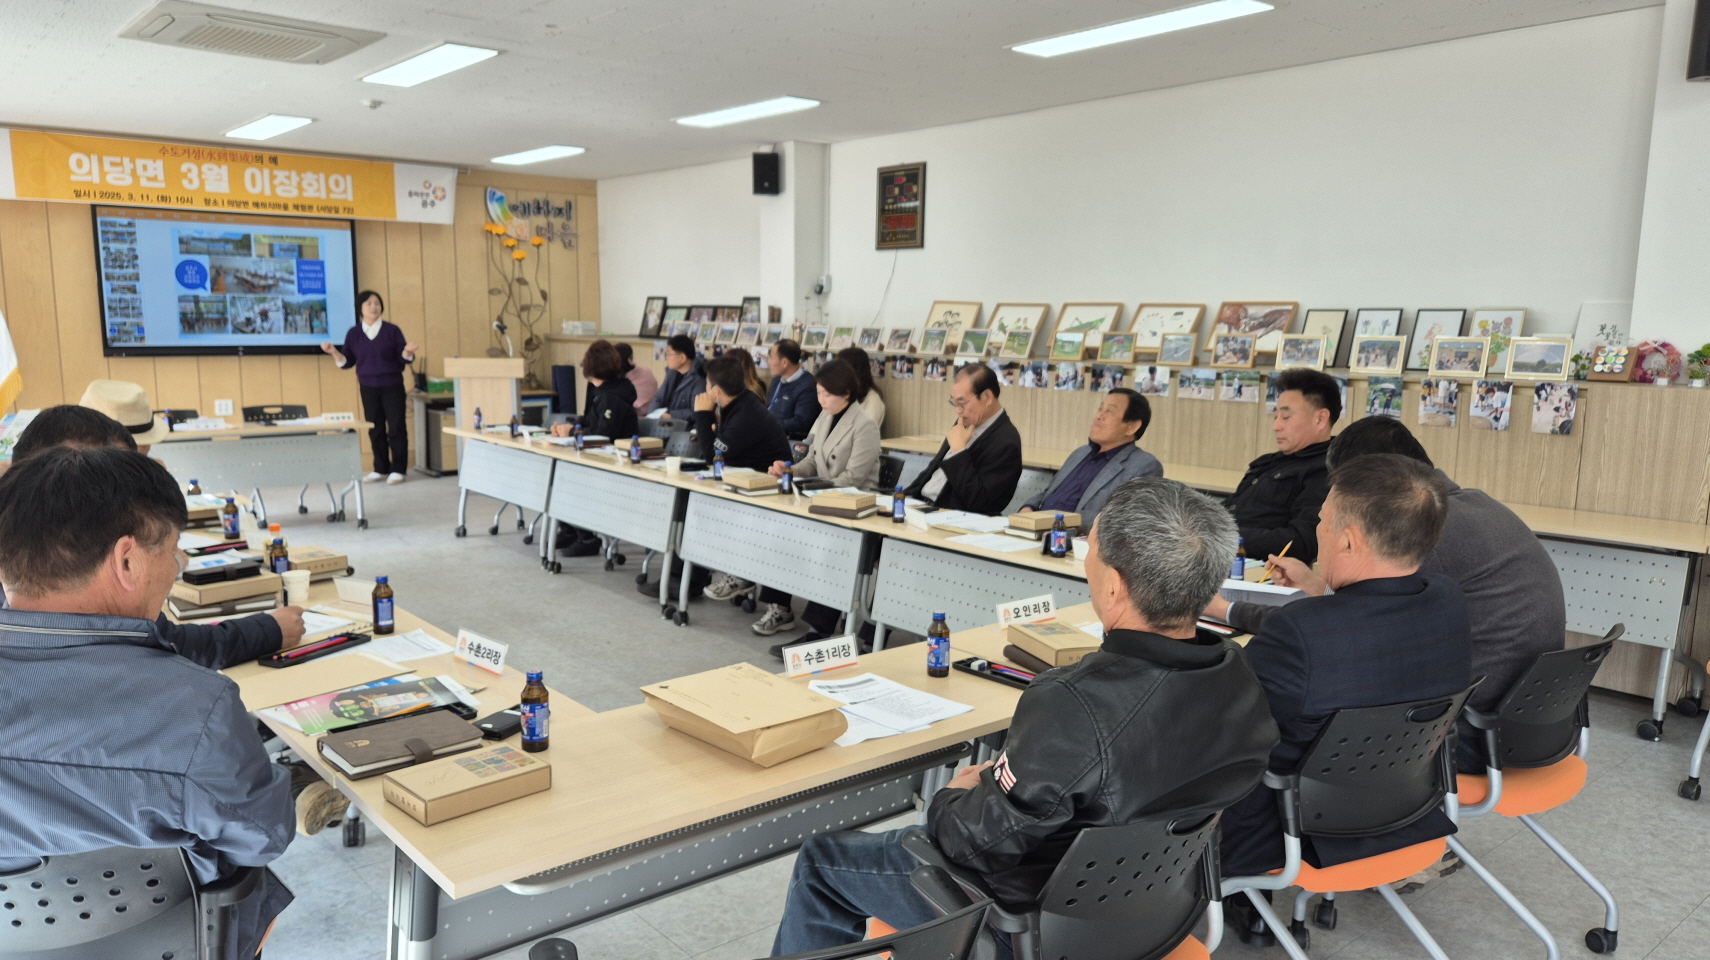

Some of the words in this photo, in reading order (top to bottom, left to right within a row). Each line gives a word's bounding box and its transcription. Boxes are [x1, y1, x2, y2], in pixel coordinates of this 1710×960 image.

[68, 153, 166, 188] 의당면
[180, 161, 230, 194] 3월
[244, 166, 354, 202] 이장회의
[73, 189, 91, 199] 일시
[156, 194, 172, 204] (화)
[175, 196, 194, 205] 10시
[204, 198, 219, 207] 장소
[227, 199, 250, 208] 의당면
[510, 199, 572, 221] 예하지
[536, 221, 578, 250] 마을
[1013, 600, 1051, 619] 오인리장
[467, 641, 502, 665] 수촌2리장
[804, 643, 851, 666] 수촌1리장
